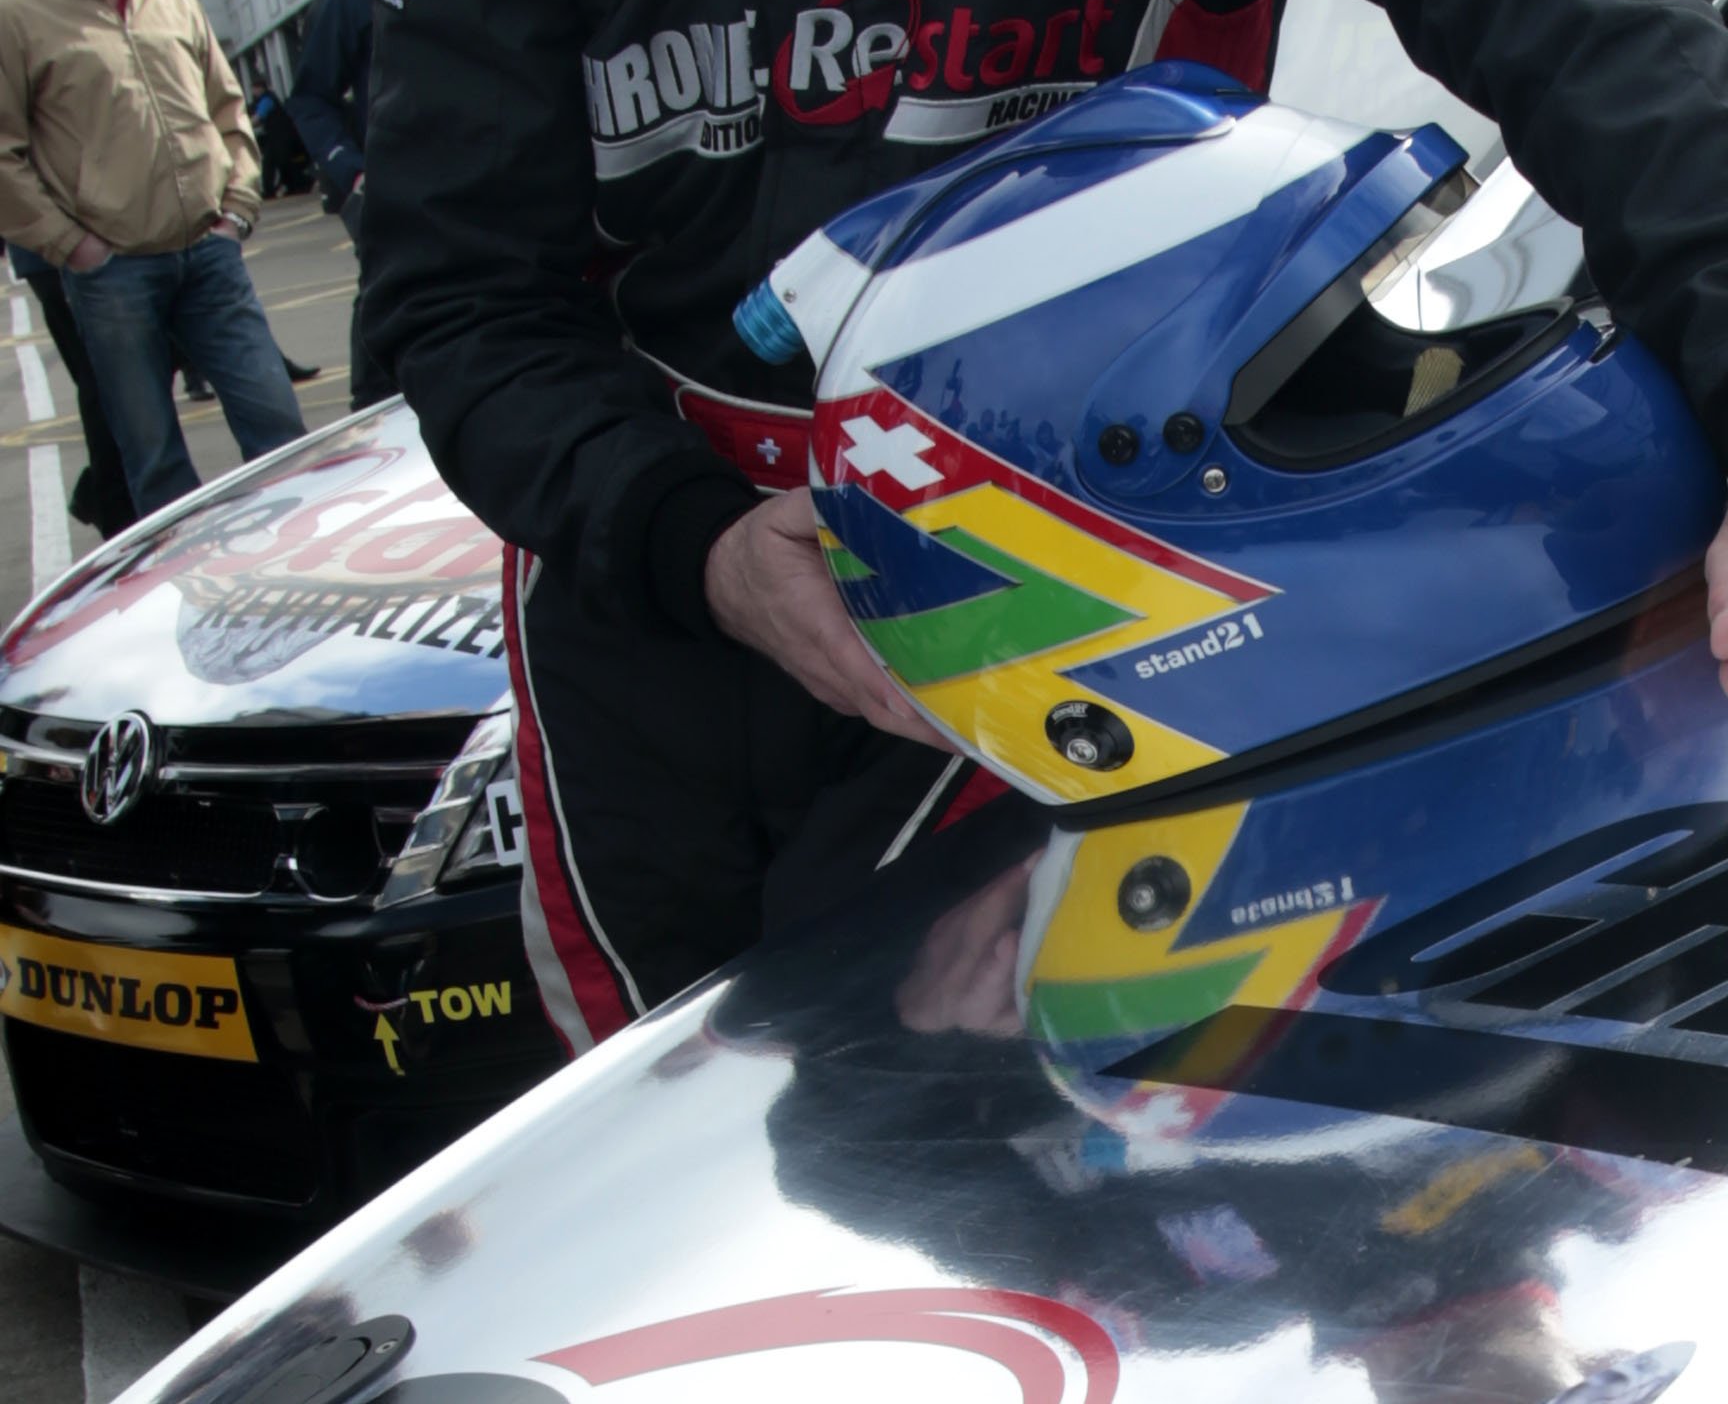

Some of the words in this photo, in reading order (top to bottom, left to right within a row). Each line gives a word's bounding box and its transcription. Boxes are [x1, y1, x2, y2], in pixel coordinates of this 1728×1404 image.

[985, 91, 1082, 129] RACIN
[1135, 612, 1264, 679] stand21
[17, 957, 239, 1029] DUNLOP
[409, 981, 511, 1024] TOW
